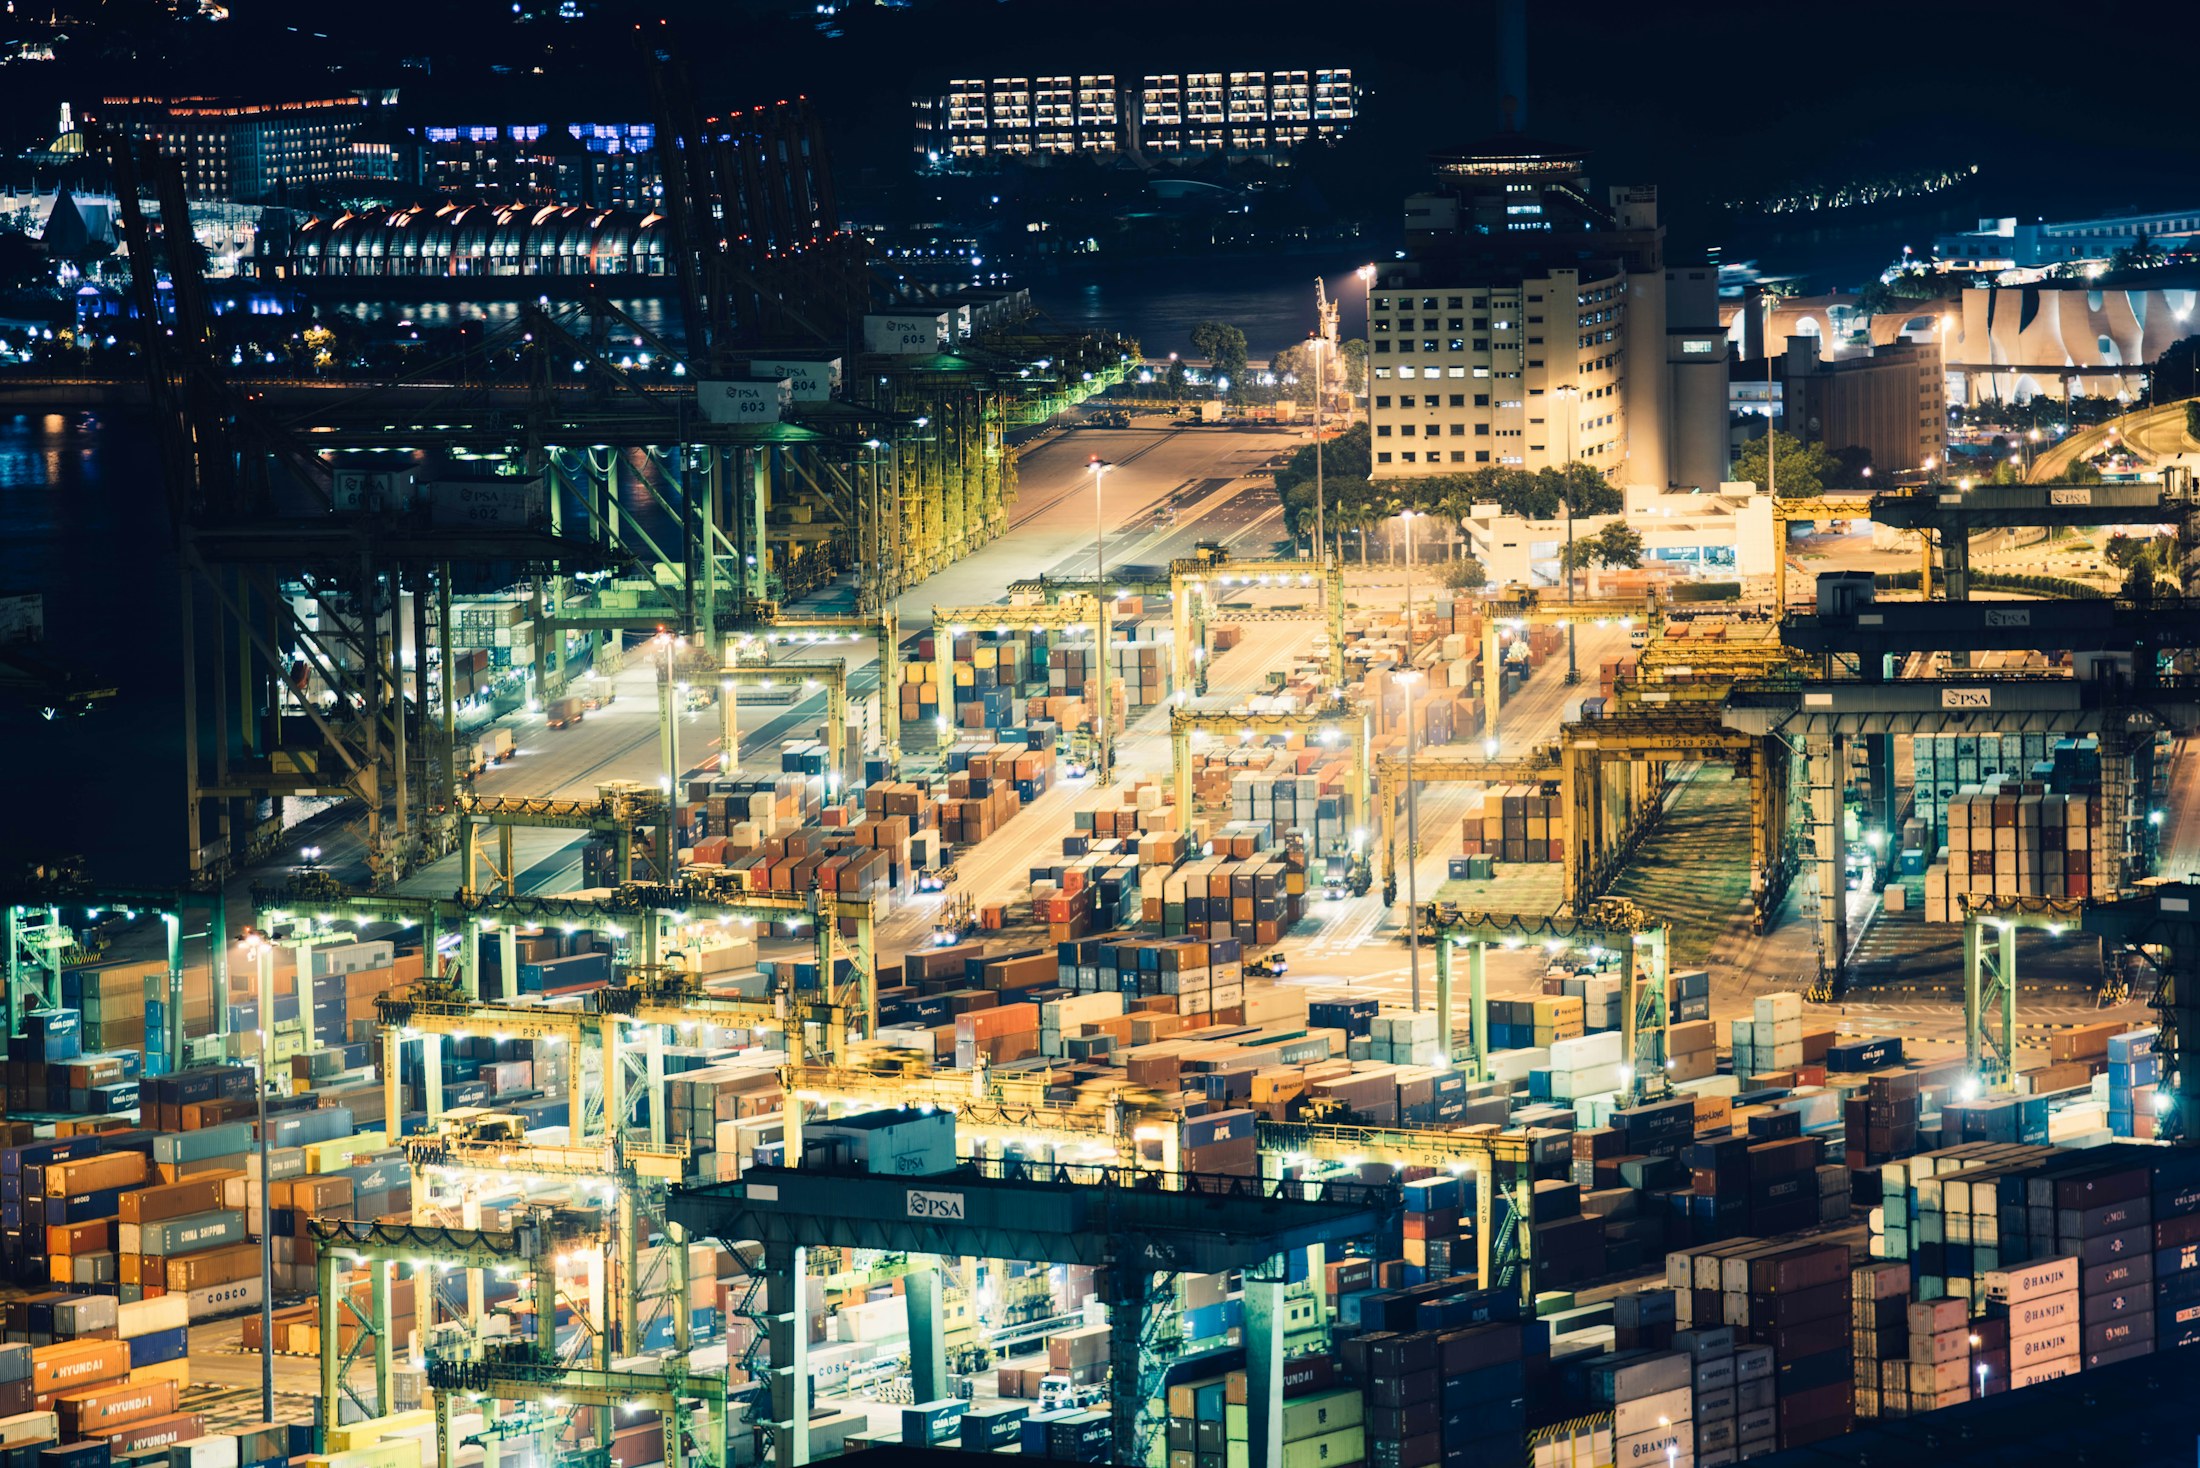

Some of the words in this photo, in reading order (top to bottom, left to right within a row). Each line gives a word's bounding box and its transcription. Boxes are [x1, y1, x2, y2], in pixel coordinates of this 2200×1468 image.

[898, 323, 917, 331] PSA
[904, 335, 926, 343] 605
[787, 369, 807, 377] PSA
[793, 382, 817, 391] 604
[739, 390, 760, 398] PSA
[742, 403, 766, 412] 603
[349, 494, 367, 505] 60
[475, 494, 498, 502] PSA
[2065, 494, 2088, 502] PSA
[471, 509, 498, 519] 602
[2002, 615, 2027, 624] PSA
[1961, 694, 1988, 705] PSA
[576, 820, 592, 828] PSA
[1576, 937, 1594, 946] PSA
[523, 1028, 542, 1037] PSA
[94, 1069, 120, 1079] HYUNDAI
[113, 1096, 125, 1104] CMA
[126, 1094, 138, 1102] CGM
[459, 1094, 470, 1102] CMA
[472, 1092, 484, 1100] CGM
[1440, 1106, 1450, 1115] CMA
[1452, 1104, 1462, 1112] CGM
[1694, 1110, 1724, 1123] apag-Lloyd
[1214, 1126, 1231, 1140] APL
[906, 1157, 924, 1168] PSA
[1424, 1155, 1446, 1164] PSA
[928, 1200, 962, 1216] PSA
[2111, 1210, 2126, 1221] MOL
[181, 1228, 196, 1242] CHINA
[200, 1224, 226, 1238] SHIPPING
[478, 1256, 500, 1266] PSA
[2181, 1252, 2198, 1269] APL
[2032, 1270, 2064, 1287] HANJIN
[2113, 1268, 2128, 1279] MOL
[208, 1288, 246, 1304] COSCO
[1472, 1308, 1490, 1322] APL
[2032, 1304, 2064, 1320] HANJIN
[2114, 1325, 2130, 1336] MOL
[2034, 1336, 2066, 1352] HANJIN
[60, 1359, 103, 1378] HYUNDAI
[1284, 1370, 1313, 1386] UNDAI
[109, 1396, 152, 1414] HYUNDAI
[932, 1418, 949, 1430] CMA
[950, 1415, 962, 1426] CGM
[992, 1424, 1007, 1434] CMA
[1008, 1420, 1021, 1430] CGM
[134, 1432, 178, 1450] HYUNDAI
[1082, 1432, 1098, 1442] CMA
[1641, 1436, 1678, 1454] HANJIN
